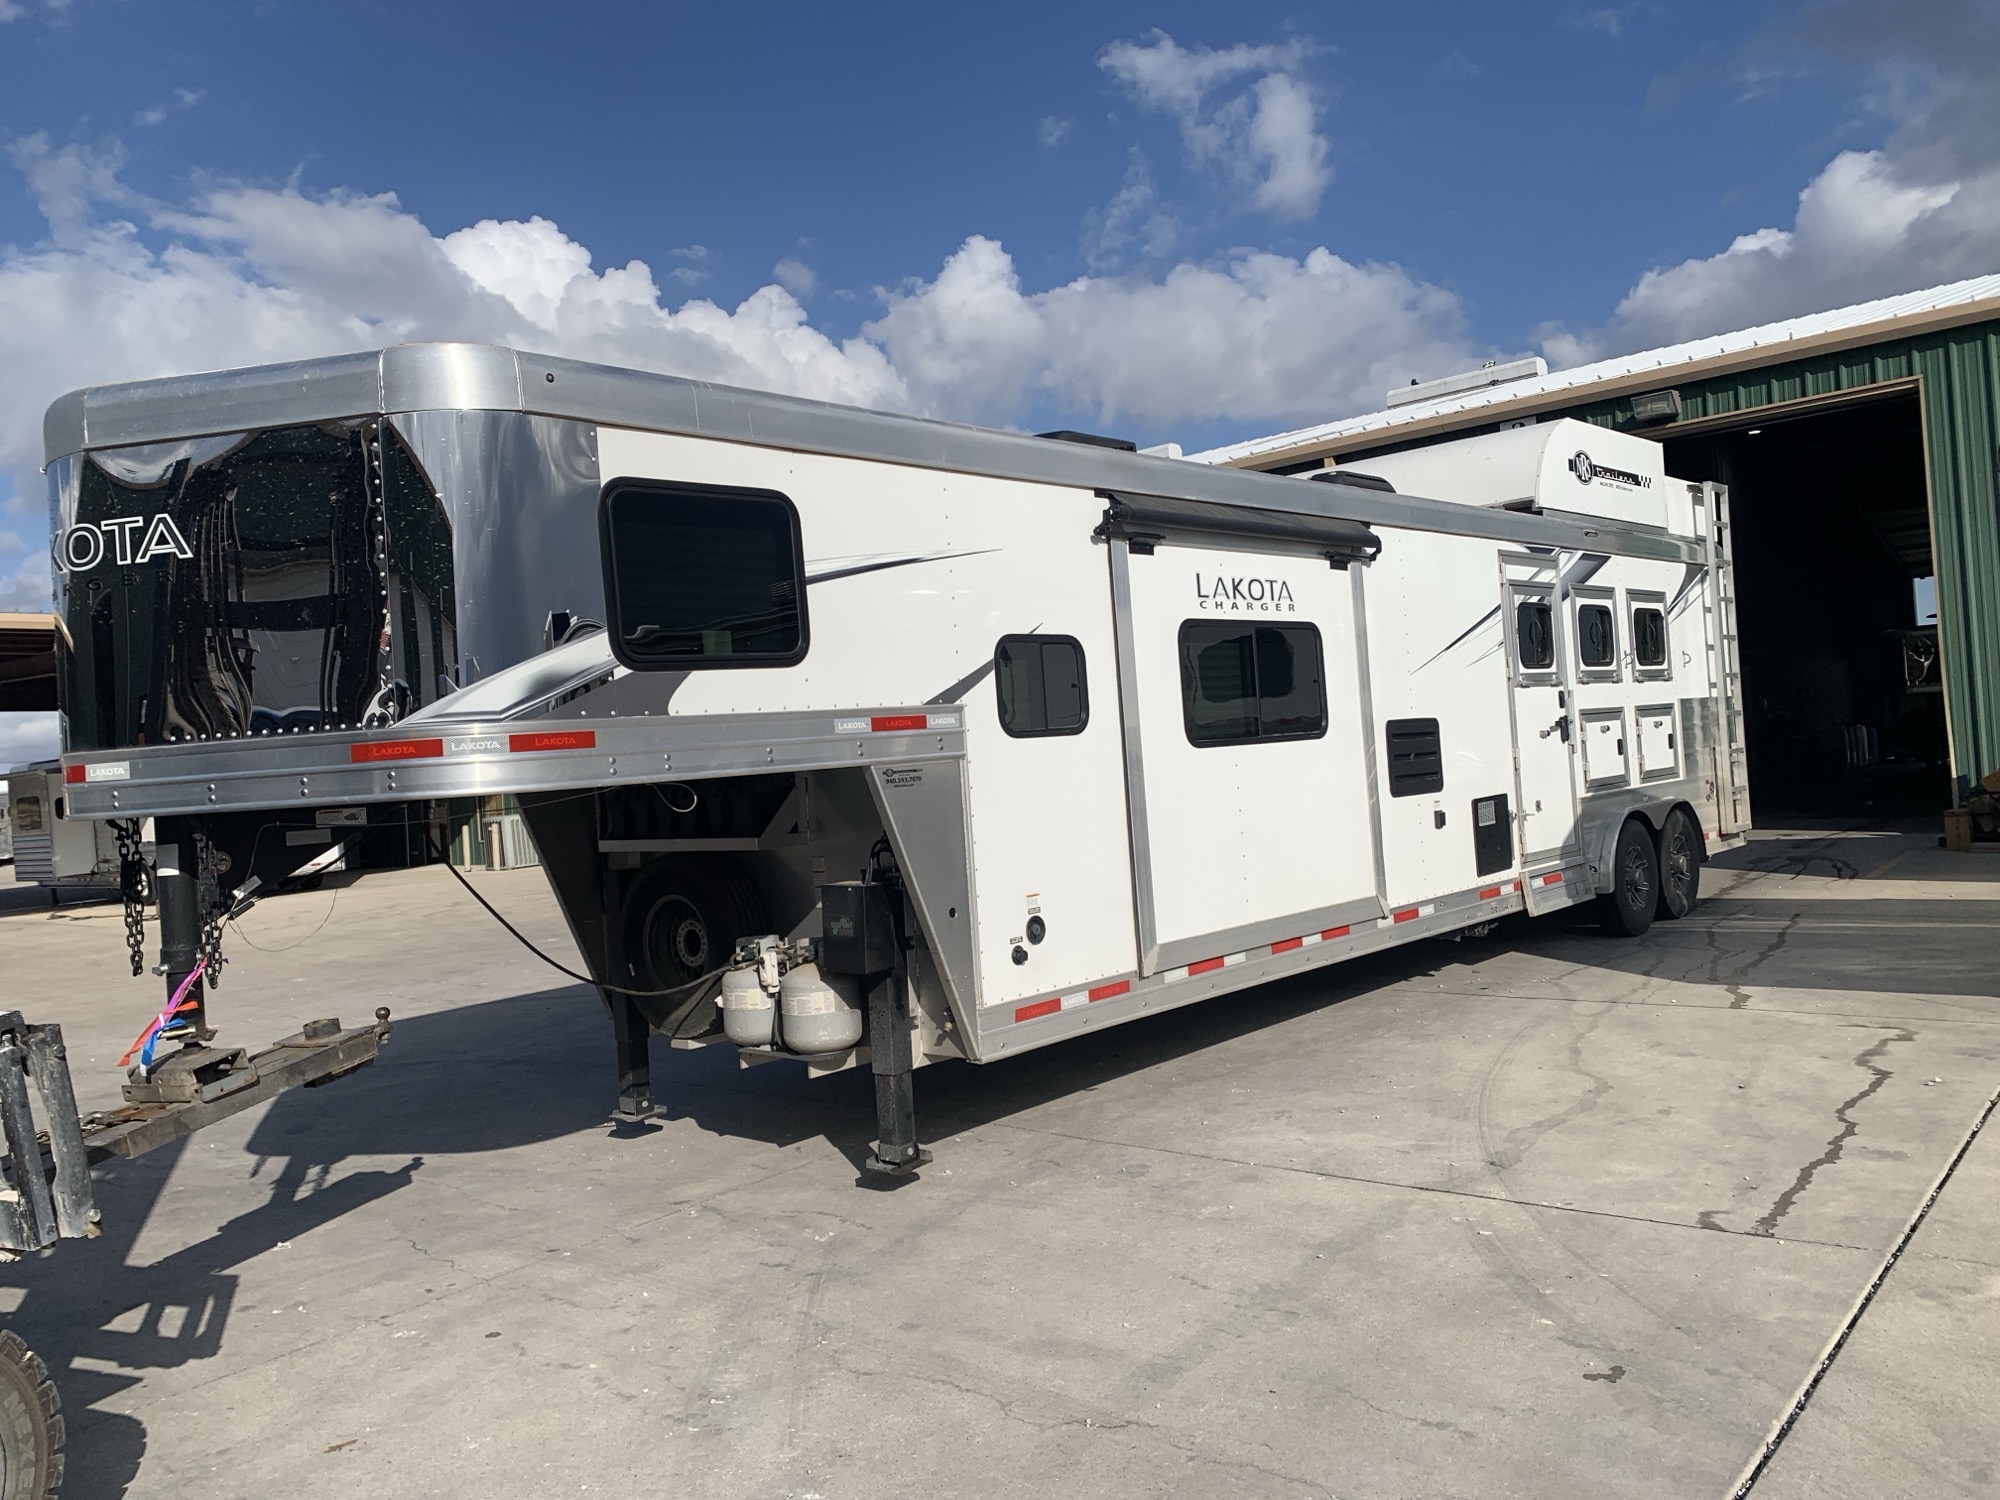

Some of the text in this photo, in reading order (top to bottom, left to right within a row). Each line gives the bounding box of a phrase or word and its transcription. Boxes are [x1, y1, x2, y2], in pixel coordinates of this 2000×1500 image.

[1575, 453, 1591, 482] NRS
[1196, 572, 1294, 602] LAKOTA
[1199, 600, 1296, 612] CHARGER
[838, 717, 956, 730] LAKOTA LAKOTA LAKOTA
[372, 736, 577, 756] LAKOTA LAKOTA LAKOTA
[89, 767, 125, 777] LAKOTA
[3, 1390, 36, 1500] NEXE
